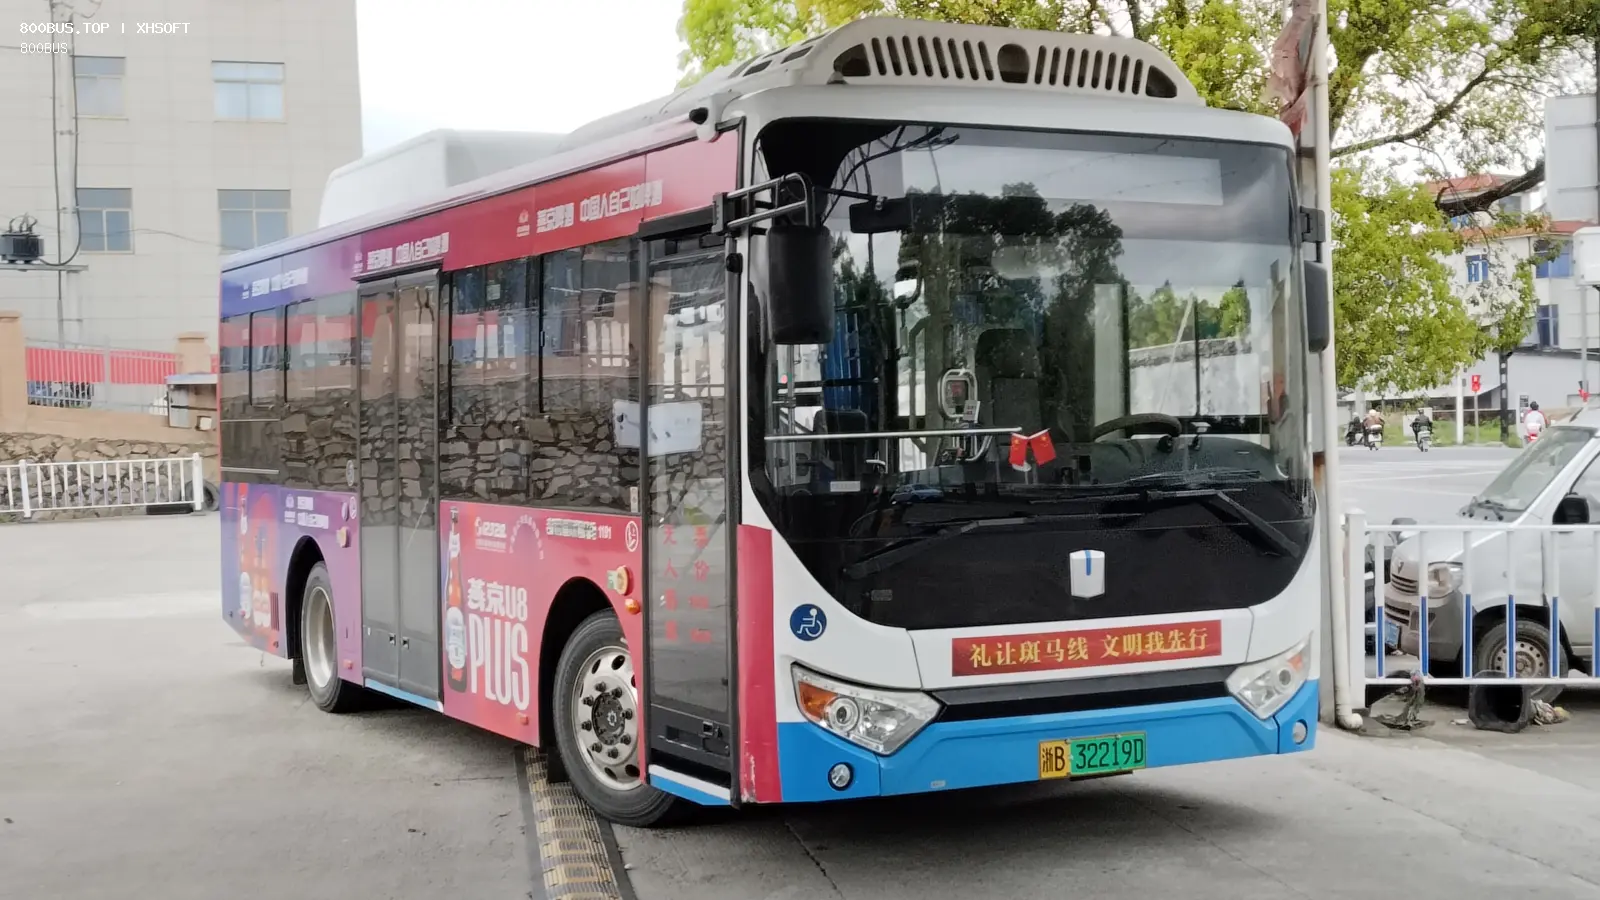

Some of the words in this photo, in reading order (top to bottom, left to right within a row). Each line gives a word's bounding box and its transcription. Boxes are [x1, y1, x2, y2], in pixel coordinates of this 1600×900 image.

[468, 612, 530, 711] PLUS
[969, 636, 1089, 668] 礼让斑马线
[1100, 628, 1208, 660] 文明我先行
